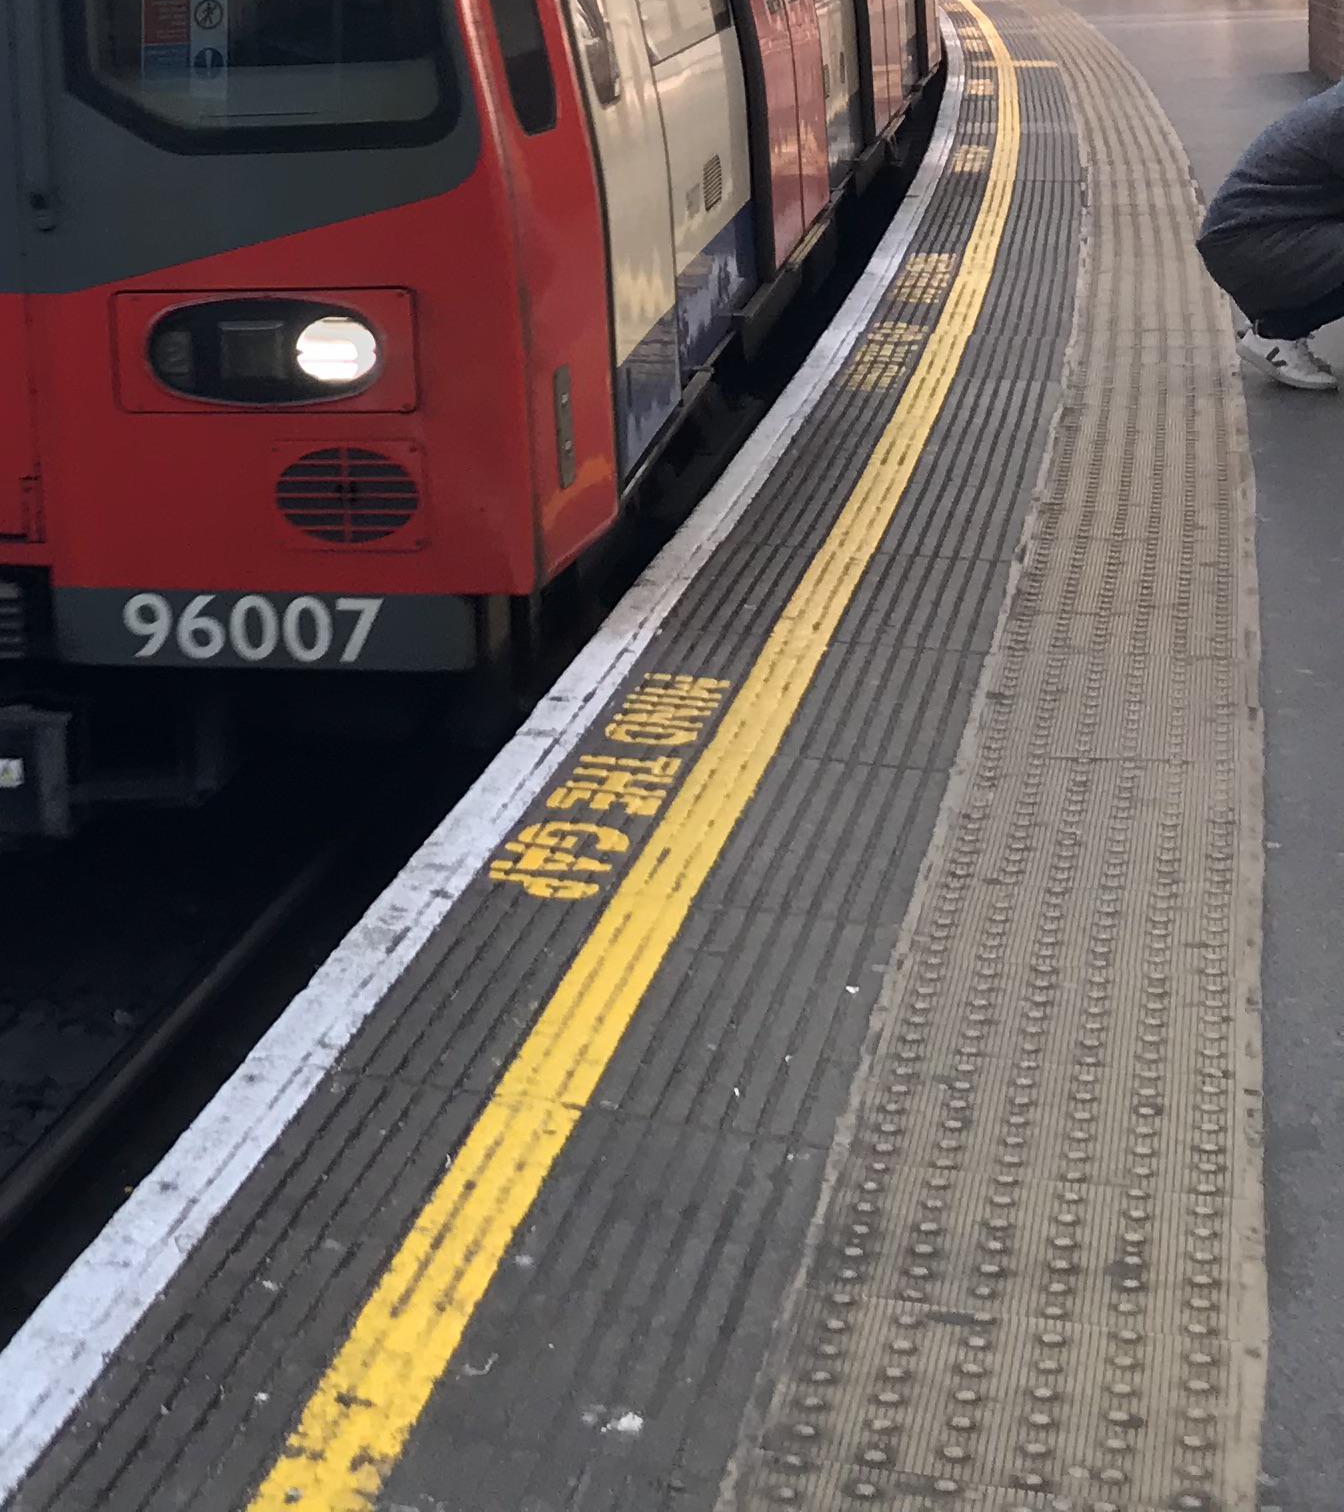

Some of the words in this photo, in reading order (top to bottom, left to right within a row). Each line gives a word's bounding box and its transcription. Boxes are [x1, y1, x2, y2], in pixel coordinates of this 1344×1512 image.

[122, 592, 385, 663] 96007
[603, 671, 732, 746] MIND
[545, 753, 683, 817] THE
[488, 820, 631, 900] GAP
